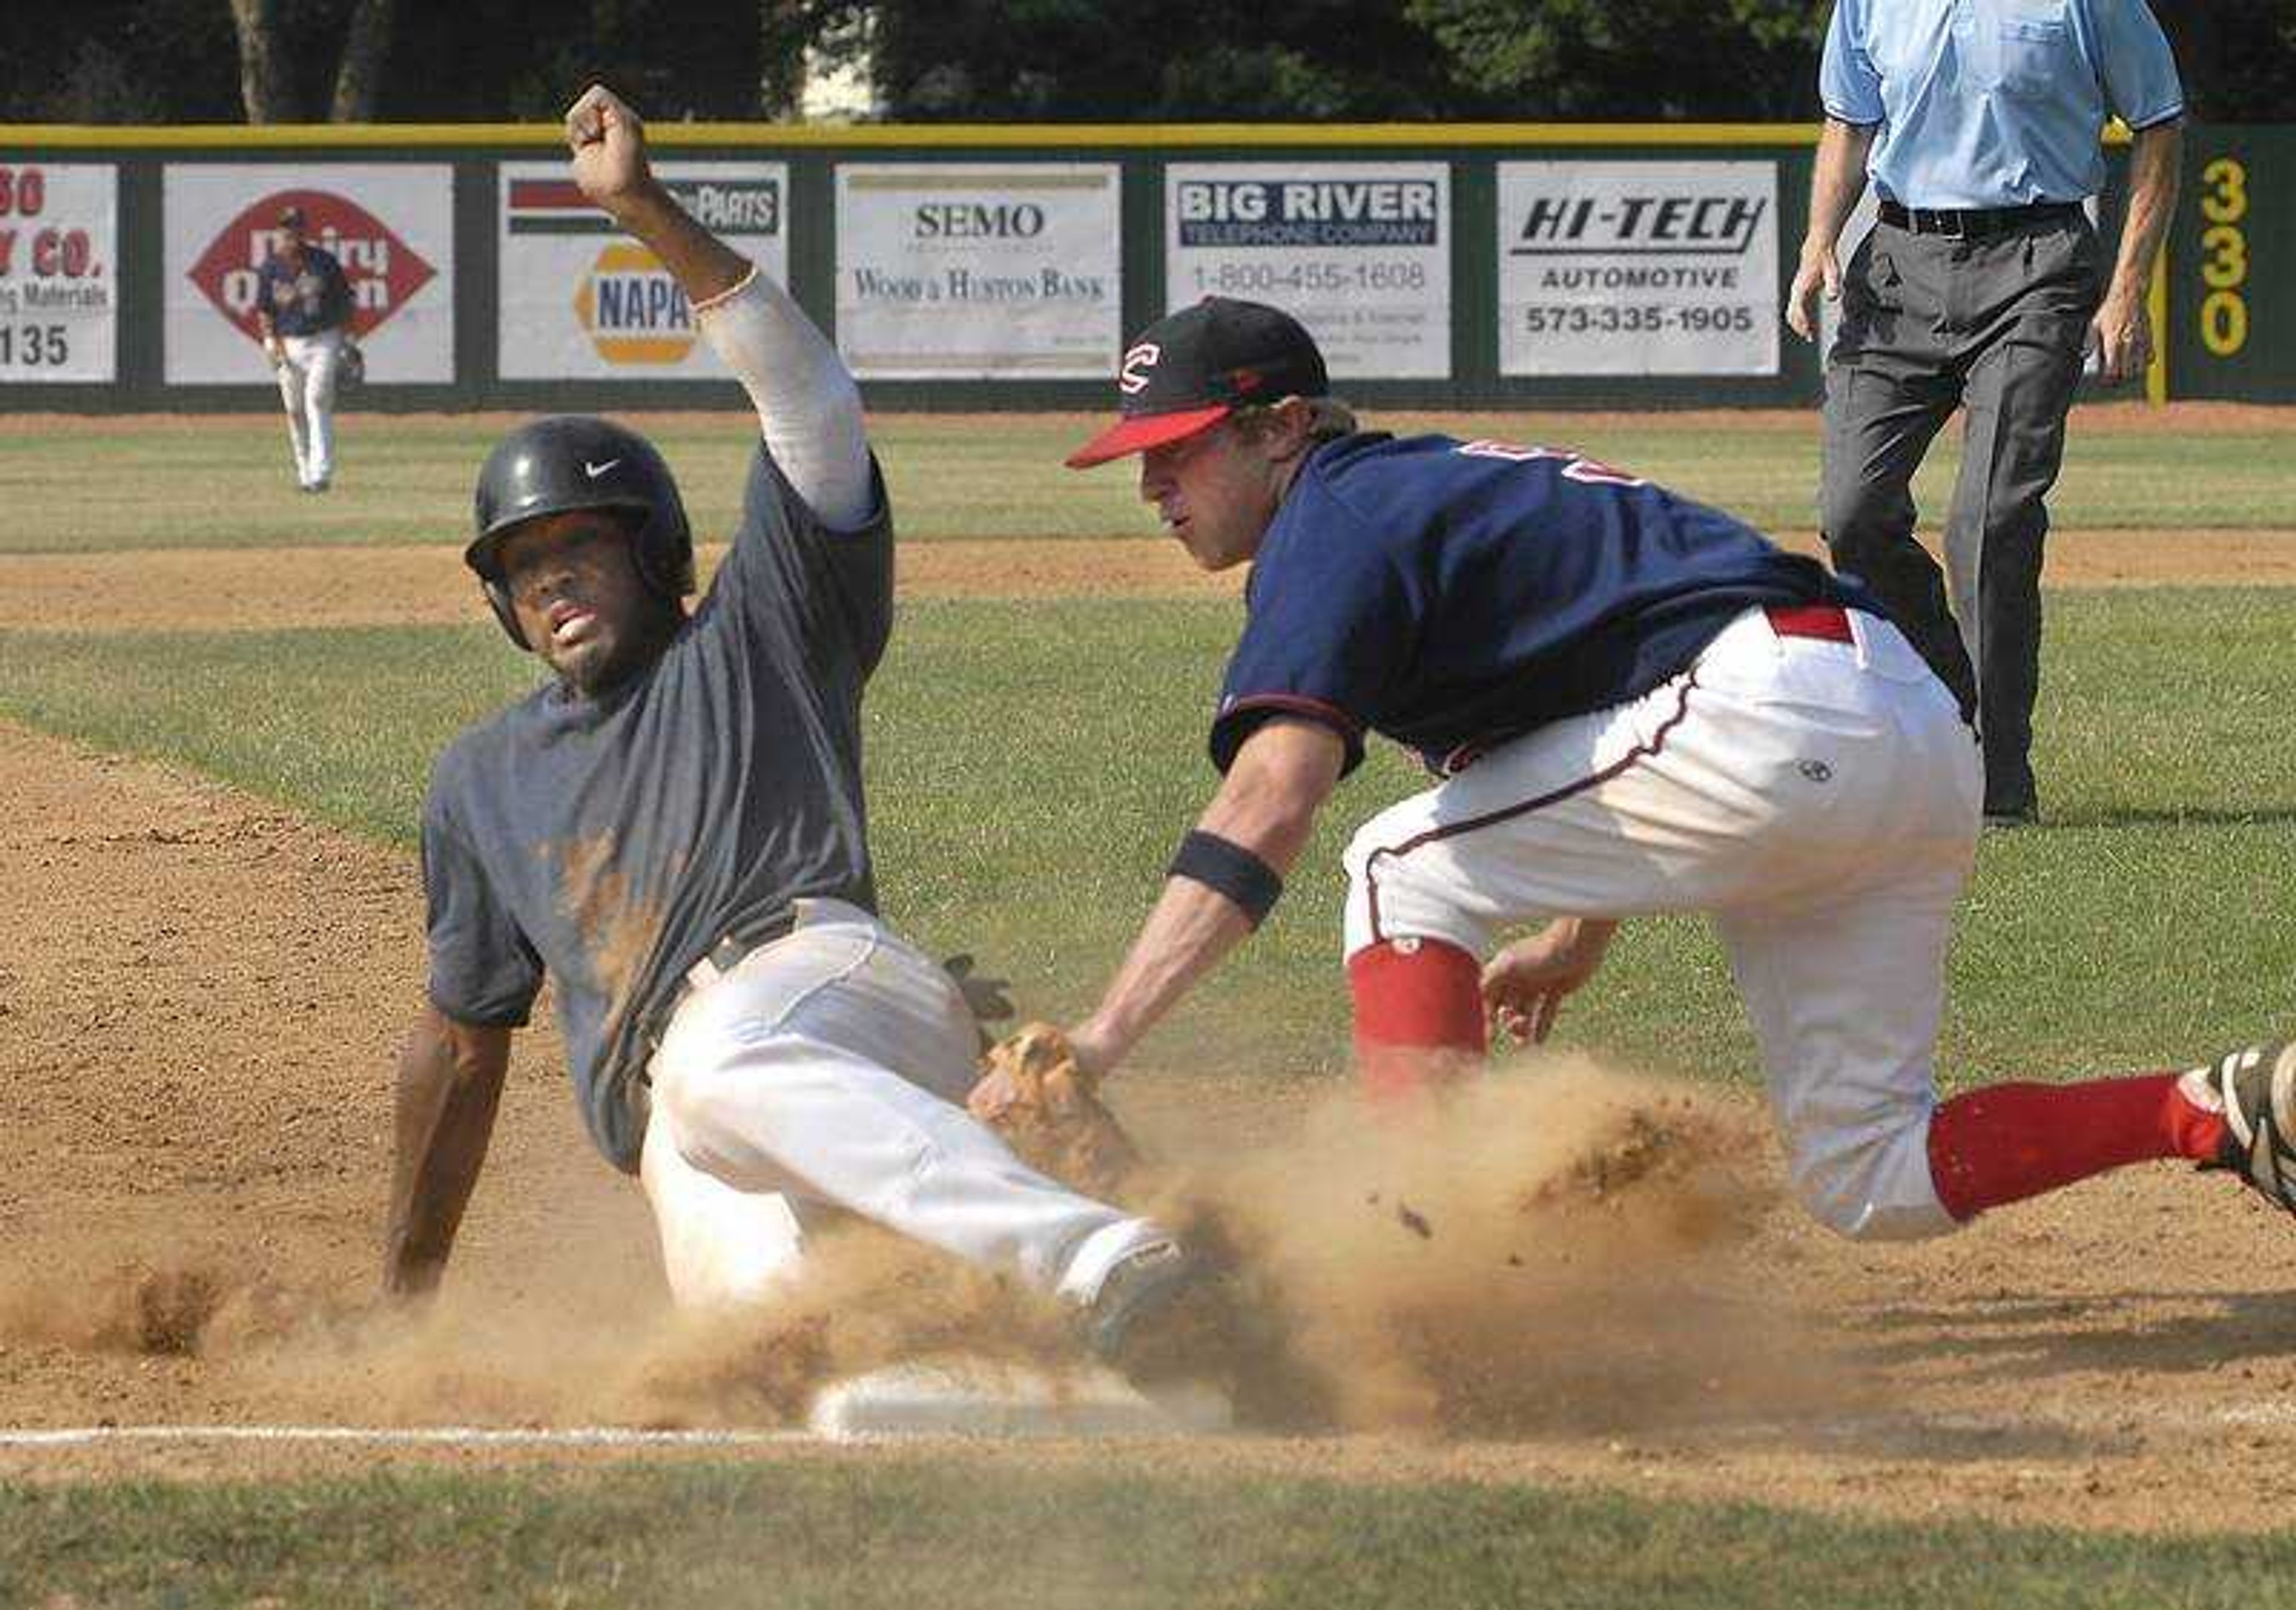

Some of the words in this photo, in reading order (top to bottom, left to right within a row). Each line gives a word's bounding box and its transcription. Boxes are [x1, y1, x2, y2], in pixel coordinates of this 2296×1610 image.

[1181, 183, 1268, 220] BIG
[1283, 183, 1434, 220] RIVER
[1521, 197, 1766, 239] HI-TECH
[914, 203, 1045, 238] SEMO
[2202, 158, 2247, 355] 330
[1541, 266, 1739, 289] AUTOMOTIVE
[599, 277, 689, 329] NAPA
[1526, 305, 1753, 333] 573-335-1905
